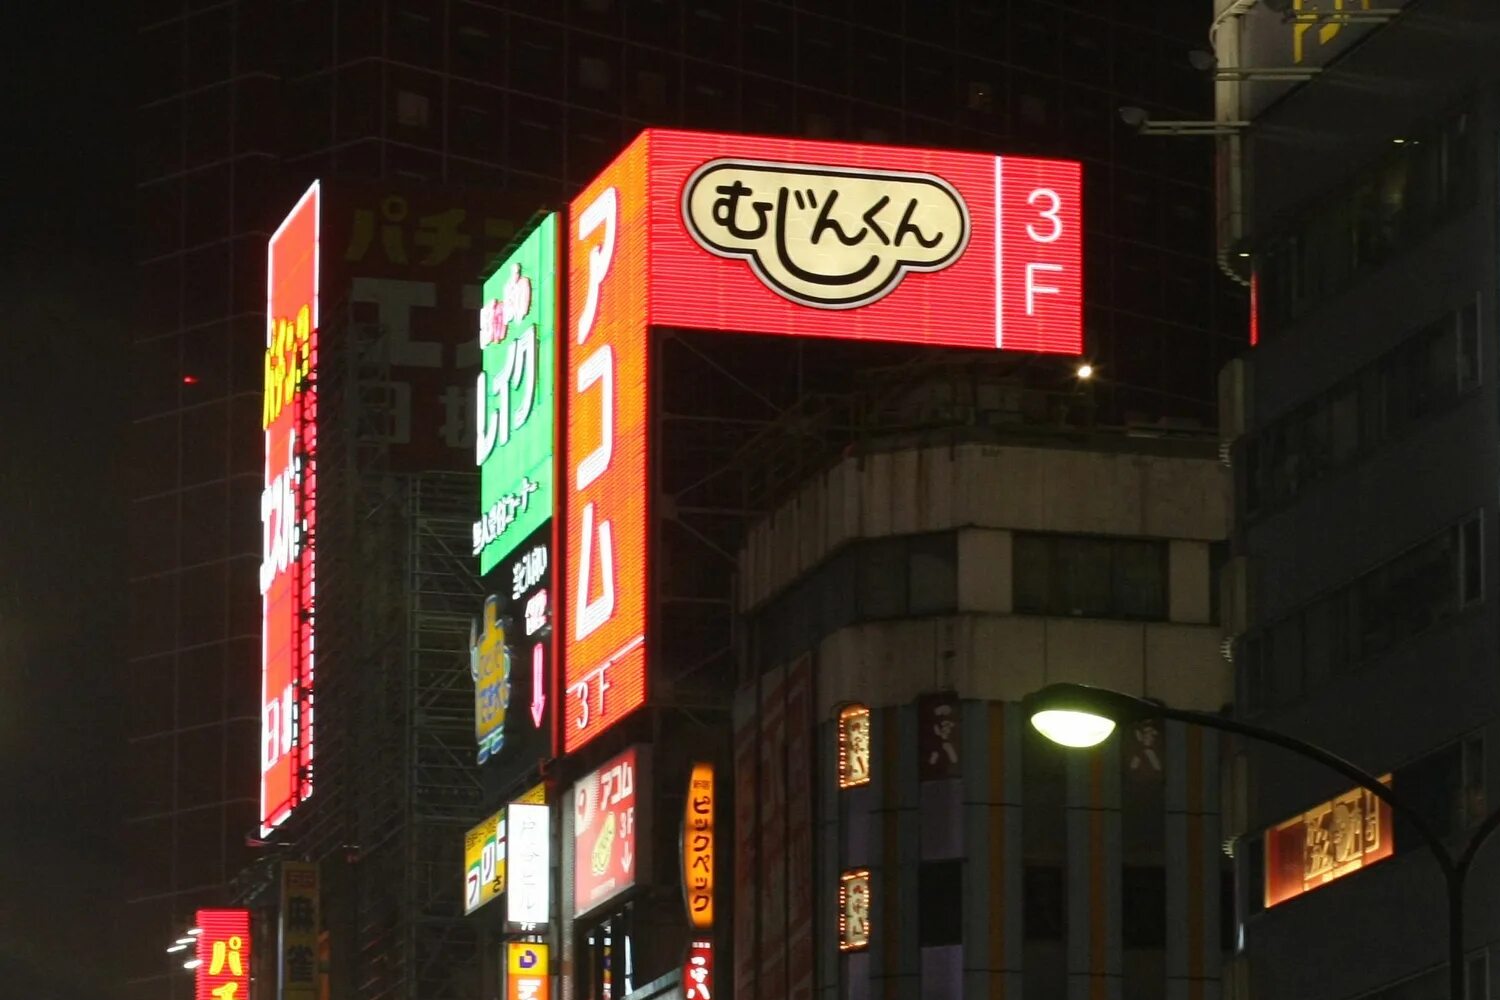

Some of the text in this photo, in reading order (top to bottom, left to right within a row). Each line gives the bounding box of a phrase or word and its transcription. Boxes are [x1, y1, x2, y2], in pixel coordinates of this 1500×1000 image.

[713, 180, 943, 286] むじんくん
[475, 323, 537, 467] レイク
[575, 187, 617, 641] アコム
[600, 762, 633, 811] アコム
[620, 807, 634, 838] 3F
